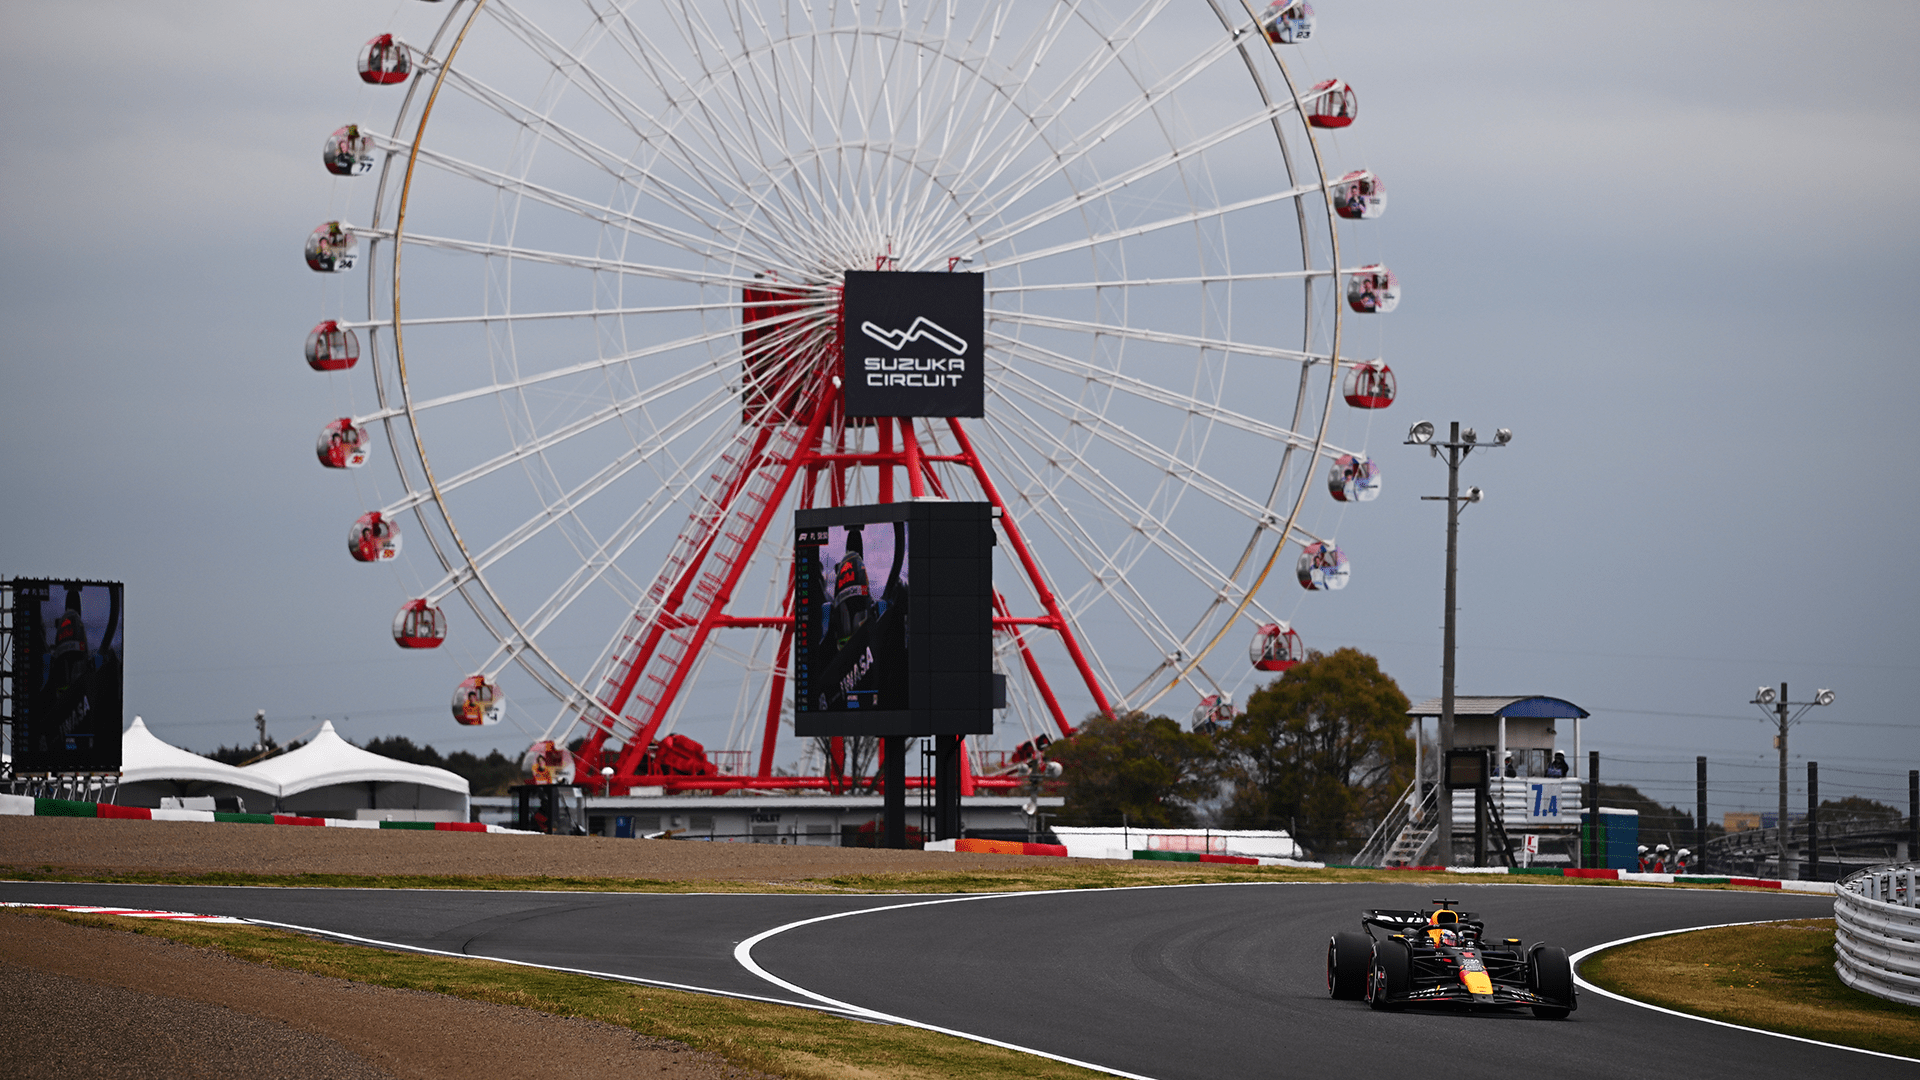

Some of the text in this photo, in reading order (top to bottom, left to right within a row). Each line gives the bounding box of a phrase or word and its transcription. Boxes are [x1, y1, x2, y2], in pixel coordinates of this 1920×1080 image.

[360, 163, 373, 172] 77
[339, 260, 352, 269] 24
[864, 357, 965, 372] SUZUKA
[866, 373, 963, 388] CIRCUIT
[1531, 784, 1557, 817] 7.4
[750, 812, 781, 823] TOILET
